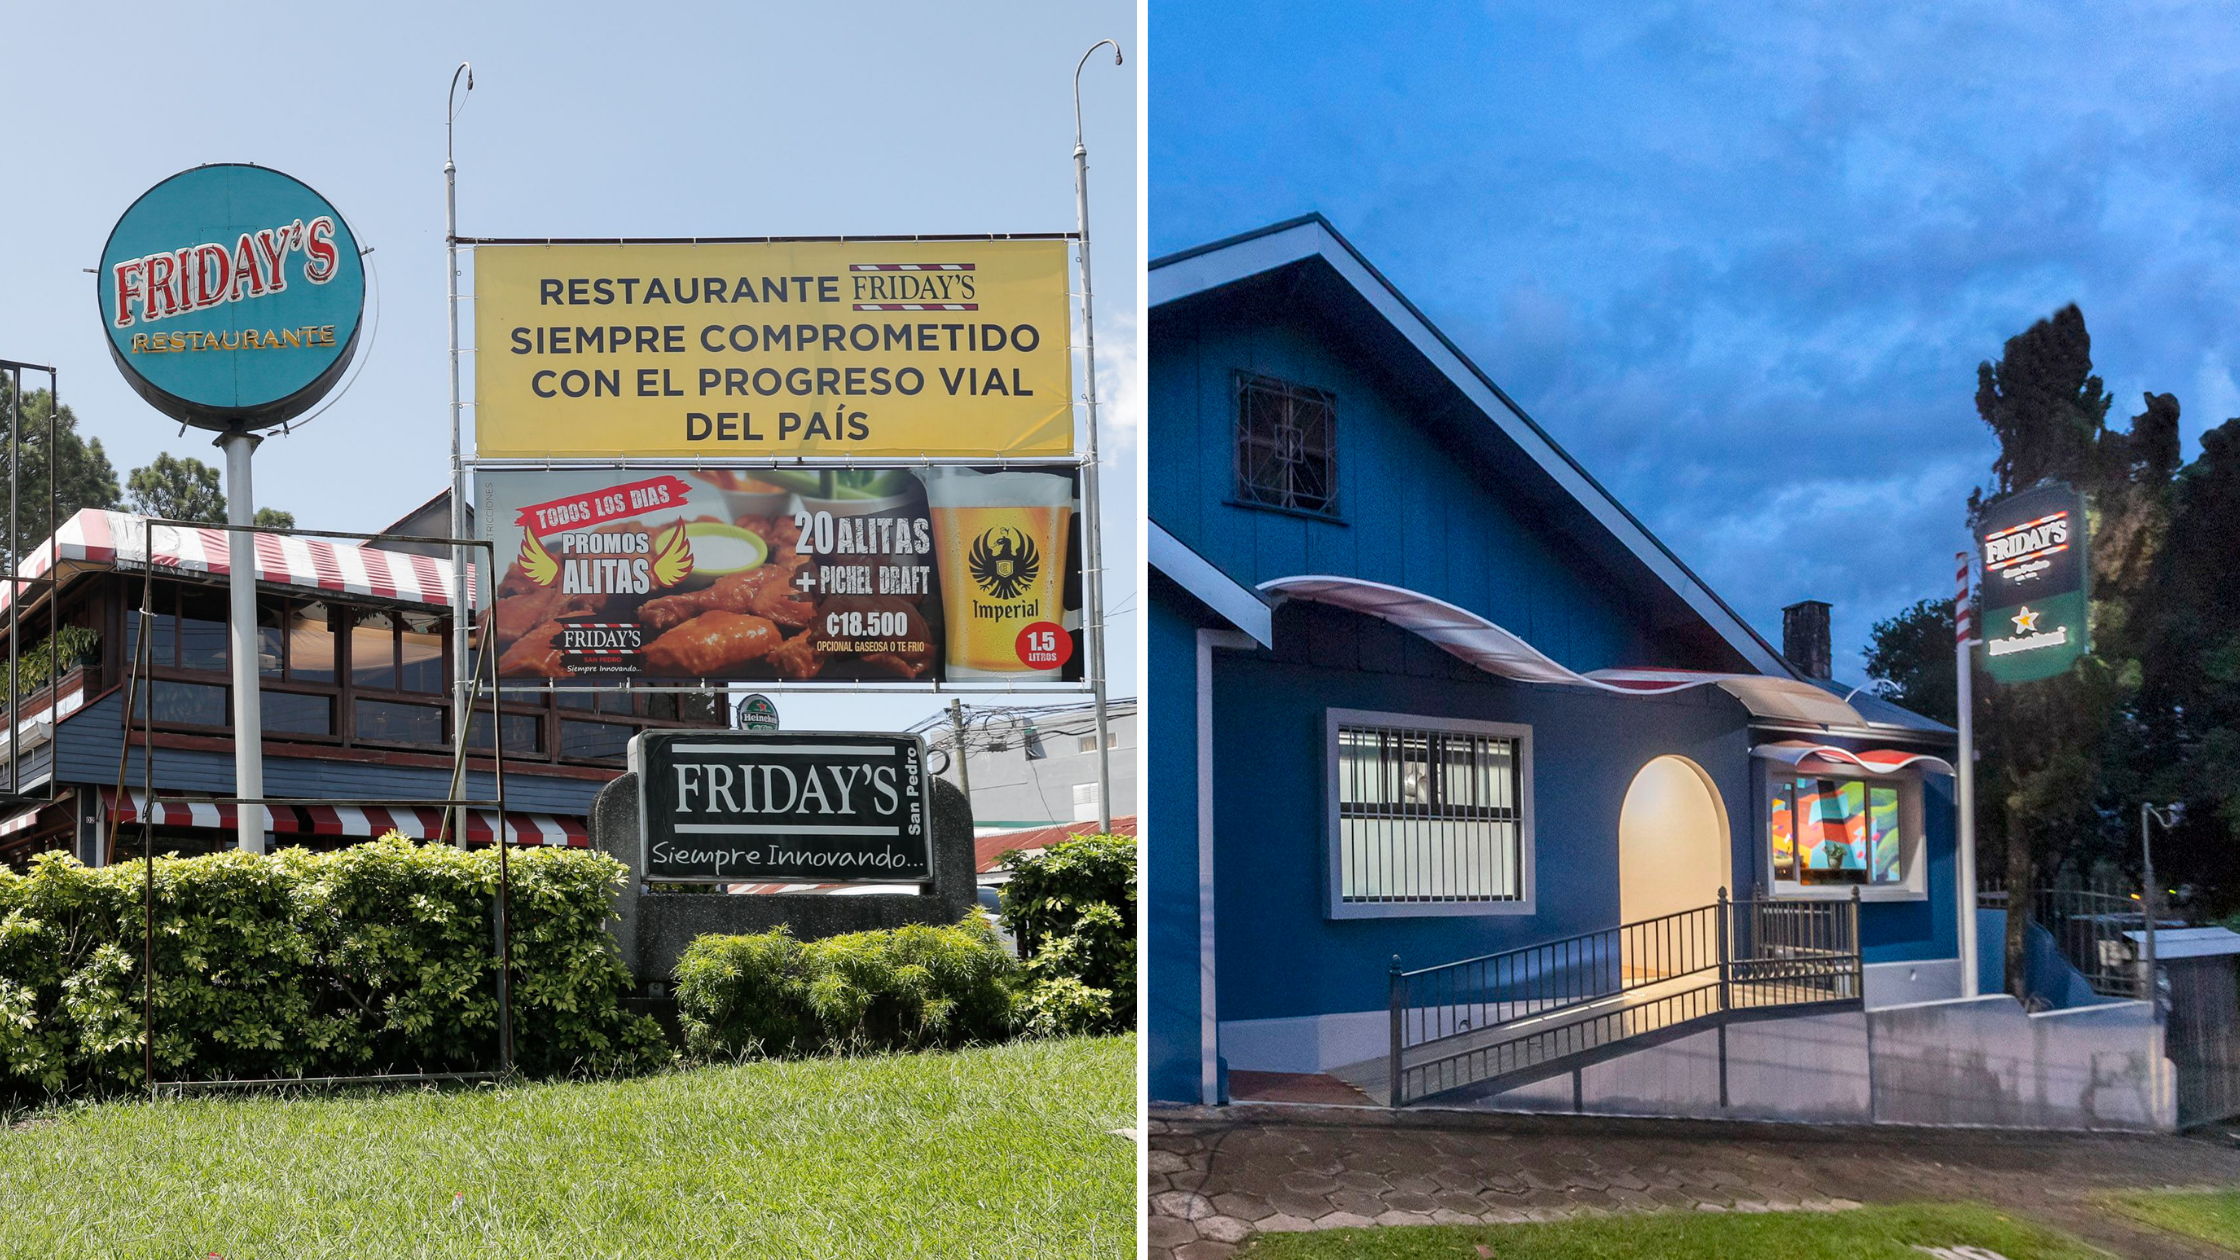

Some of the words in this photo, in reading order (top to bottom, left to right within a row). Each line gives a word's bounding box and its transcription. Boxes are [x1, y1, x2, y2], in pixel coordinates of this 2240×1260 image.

[113, 216, 339, 329] FRIDAY'S
[540, 276, 840, 305] RESTAURANTE
[851, 274, 976, 300] FRIDAY'S
[132, 325, 336, 354] RESTAURANTE
[510, 325, 685, 355] SIEMPRE
[700, 323, 1040, 353] COMPROMETIDO
[531, 369, 620, 398] CON
[637, 369, 684, 397] EL
[699, 367, 925, 397] PROGRESO
[938, 366, 1033, 396] VIAL
[686, 412, 764, 441] DEL
[778, 403, 869, 441] PAÍS
[536, 501, 591, 530] TODOS
[594, 492, 627, 516] LOS
[630, 484, 670, 509] DIAS
[562, 533, 649, 554] PROMOS
[794, 510, 834, 555] 20
[837, 517, 931, 555] ALITAS
[1985, 520, 2067, 563] FRIDAY'S
[562, 558, 650, 595] ALITAS
[820, 566, 873, 595] PICHEL
[880, 566, 930, 595] DRAFT
[972, 599, 1039, 623] Imperial
[564, 629, 641, 648] FRIDAY'S
[817, 641, 853, 653] OPCIONAL
[854, 641, 888, 653] GASEOSA
[890, 641, 895, 652] O
[896, 641, 907, 652] TE
[908, 641, 925, 652] FRIO
[1028, 631, 1055, 652] 1.5
[567, 665, 597, 674] Siempre
[1028, 652, 1057, 662] LITROS
[905, 746, 919, 797] Pedro
[672, 764, 898, 815] FRIDAY'S
[907, 800, 921, 836] San
[653, 841, 761, 875] Siempre
[767, 844, 924, 868] Innovando...
